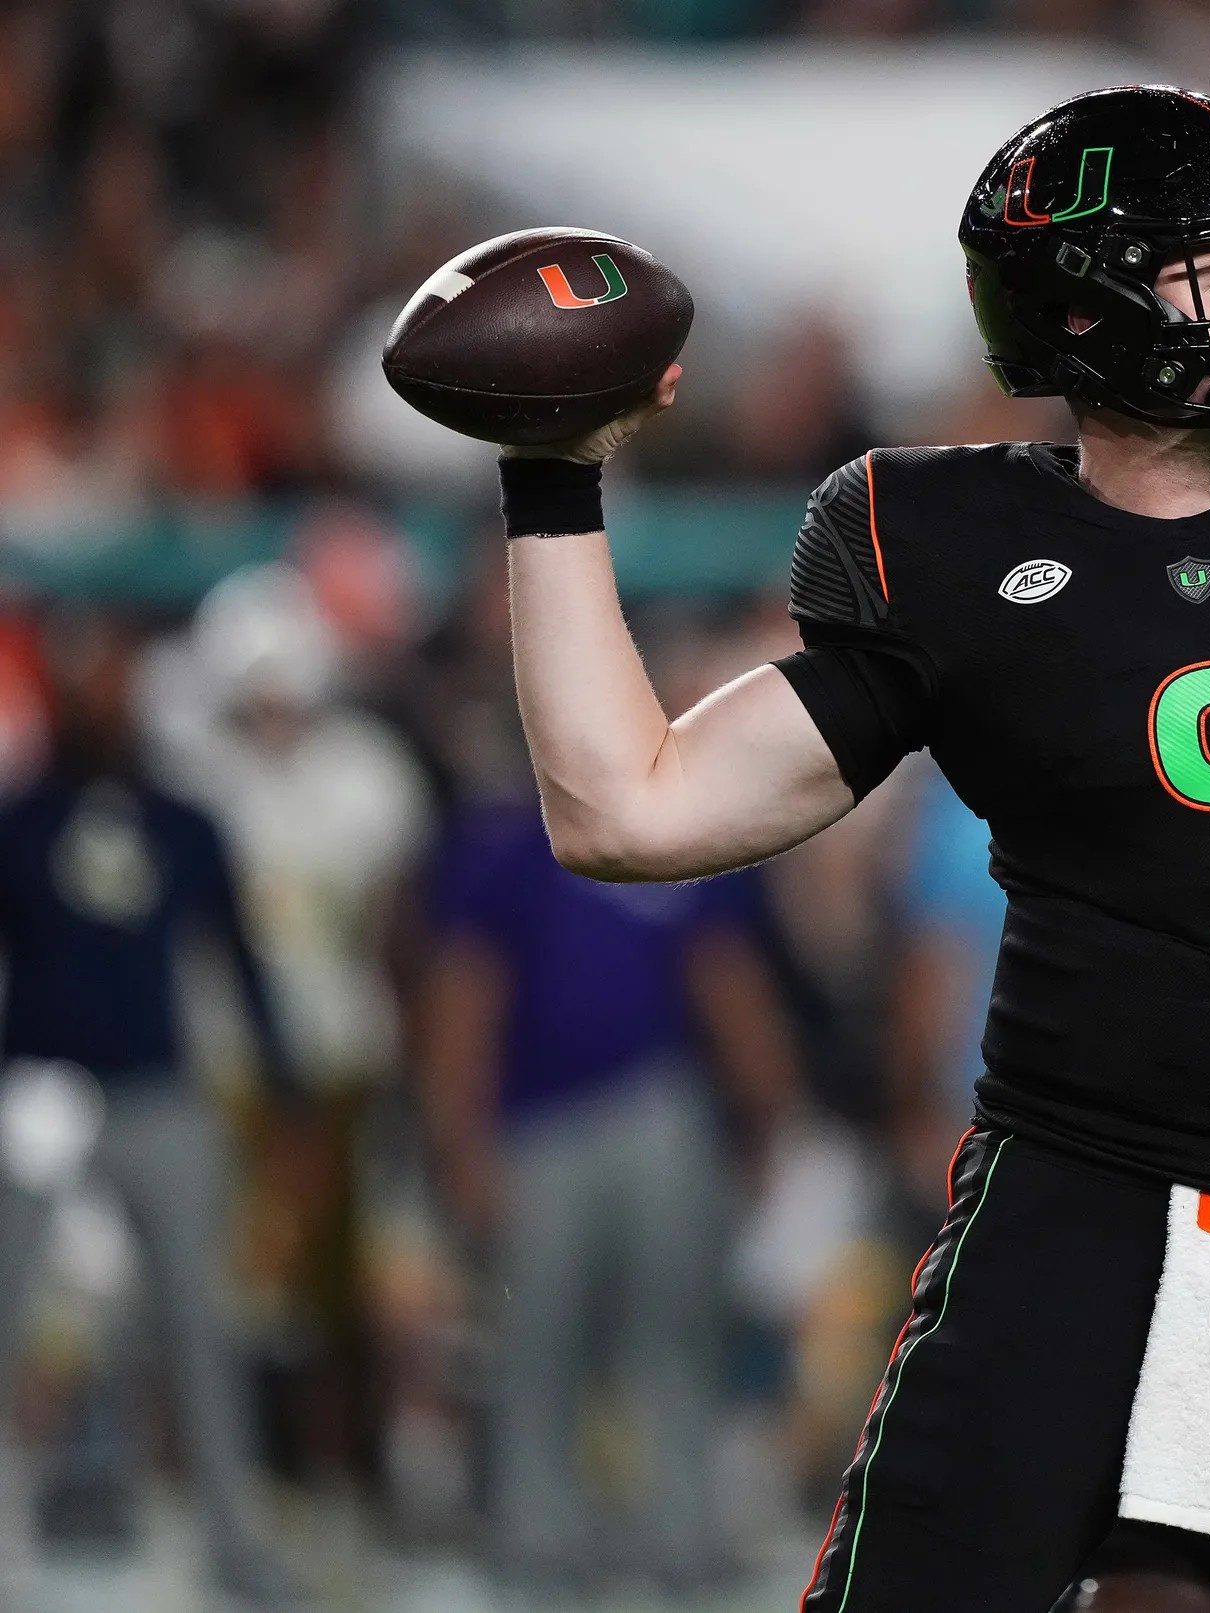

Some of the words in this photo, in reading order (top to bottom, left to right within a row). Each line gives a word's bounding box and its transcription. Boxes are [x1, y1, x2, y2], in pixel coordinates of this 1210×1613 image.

[1004, 146, 1114, 227] U
[536, 252, 629, 310] U
[1012, 566, 1057, 592] ACC
[1179, 569, 1207, 587] U
